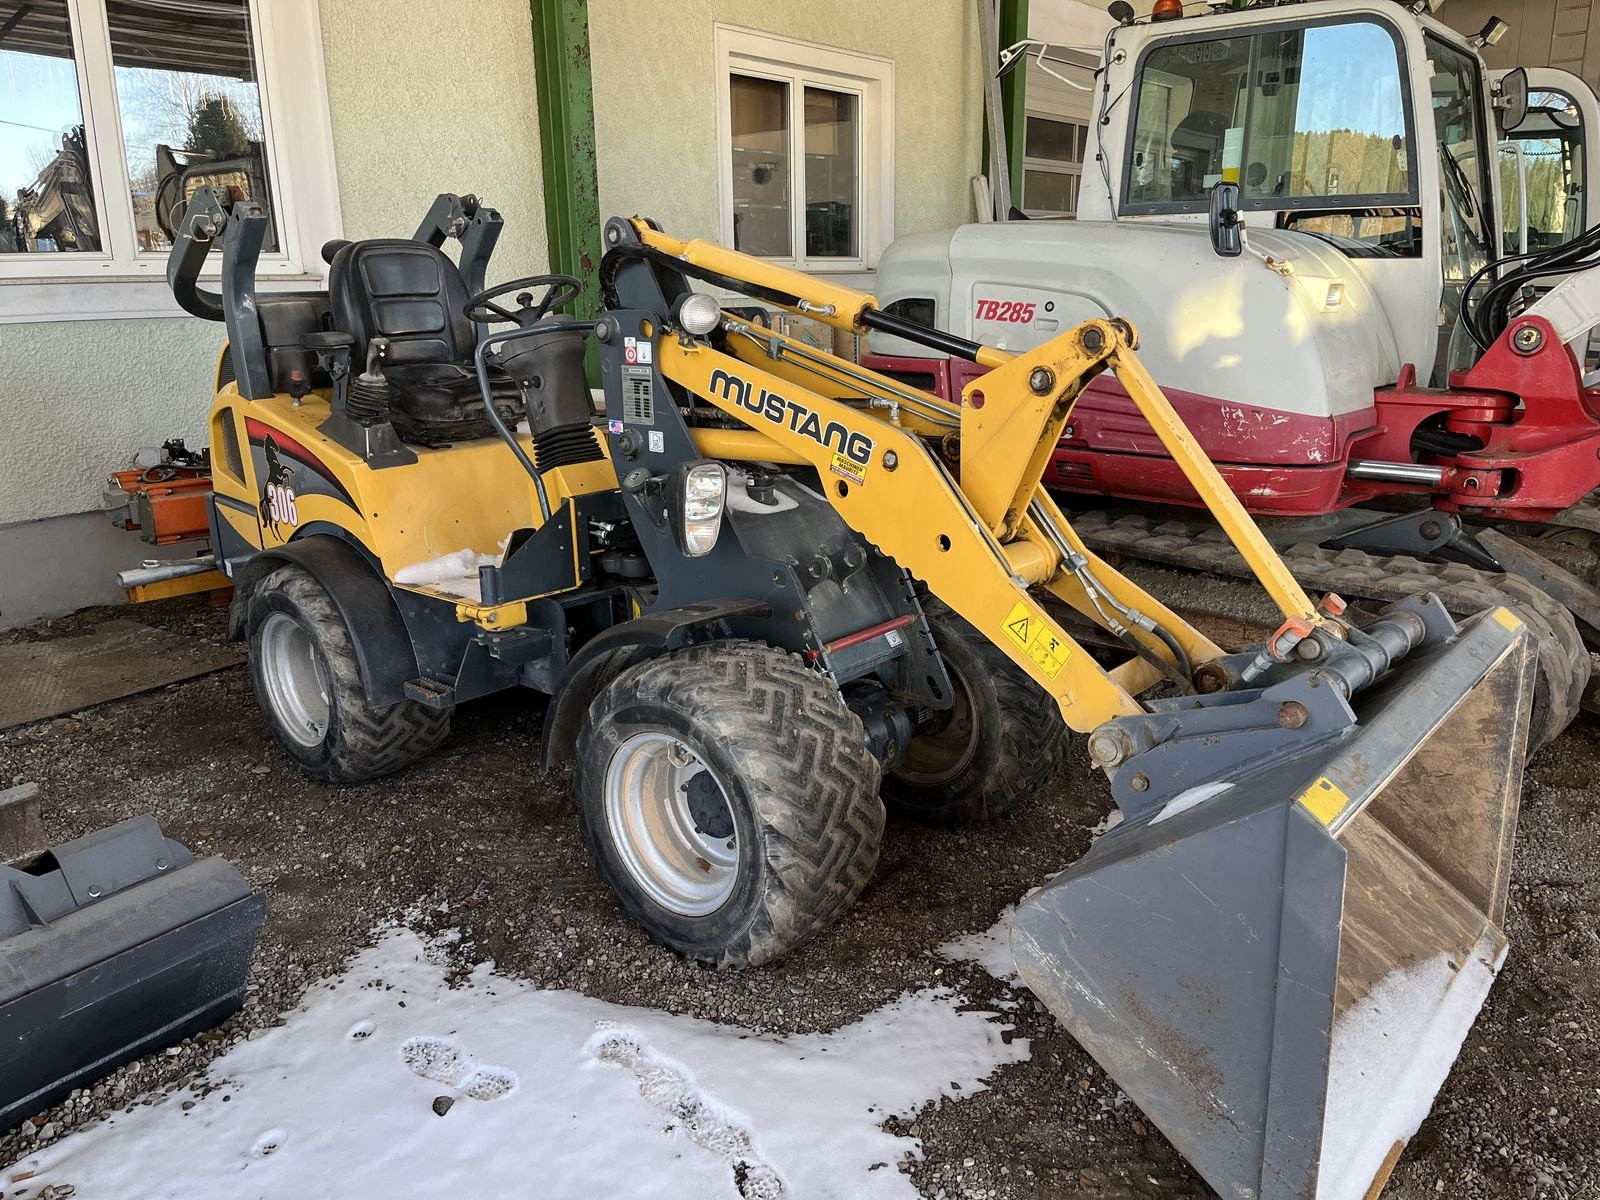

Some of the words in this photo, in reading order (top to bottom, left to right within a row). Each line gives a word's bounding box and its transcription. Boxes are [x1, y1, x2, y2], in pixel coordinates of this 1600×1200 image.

[975, 299, 1037, 324] TB285
[709, 369, 873, 465] MUSTANG
[267, 482, 298, 527] 306
